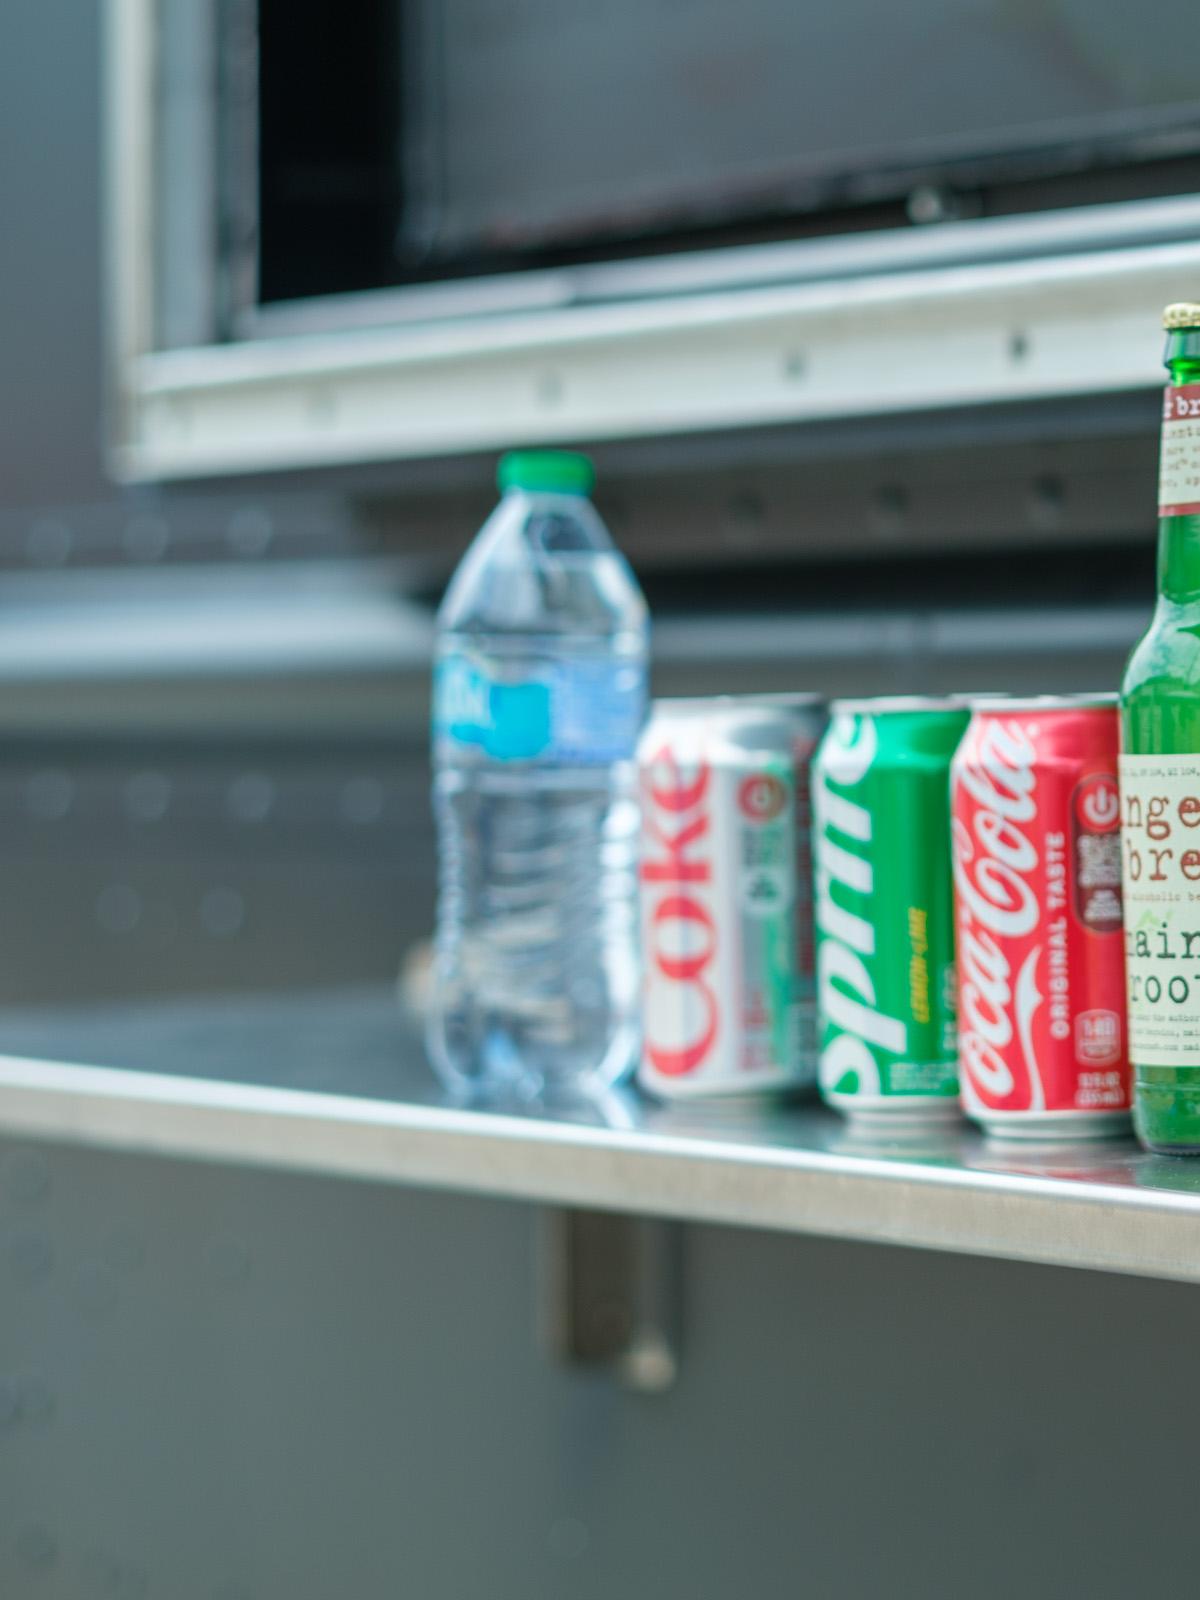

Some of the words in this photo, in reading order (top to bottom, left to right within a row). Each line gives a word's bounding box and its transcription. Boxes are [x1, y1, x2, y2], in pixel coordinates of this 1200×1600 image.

[639, 743, 718, 1078] Coke
[1046, 831, 1066, 910] TASTE
[1046, 914, 1071, 1041] ORIGINAL
